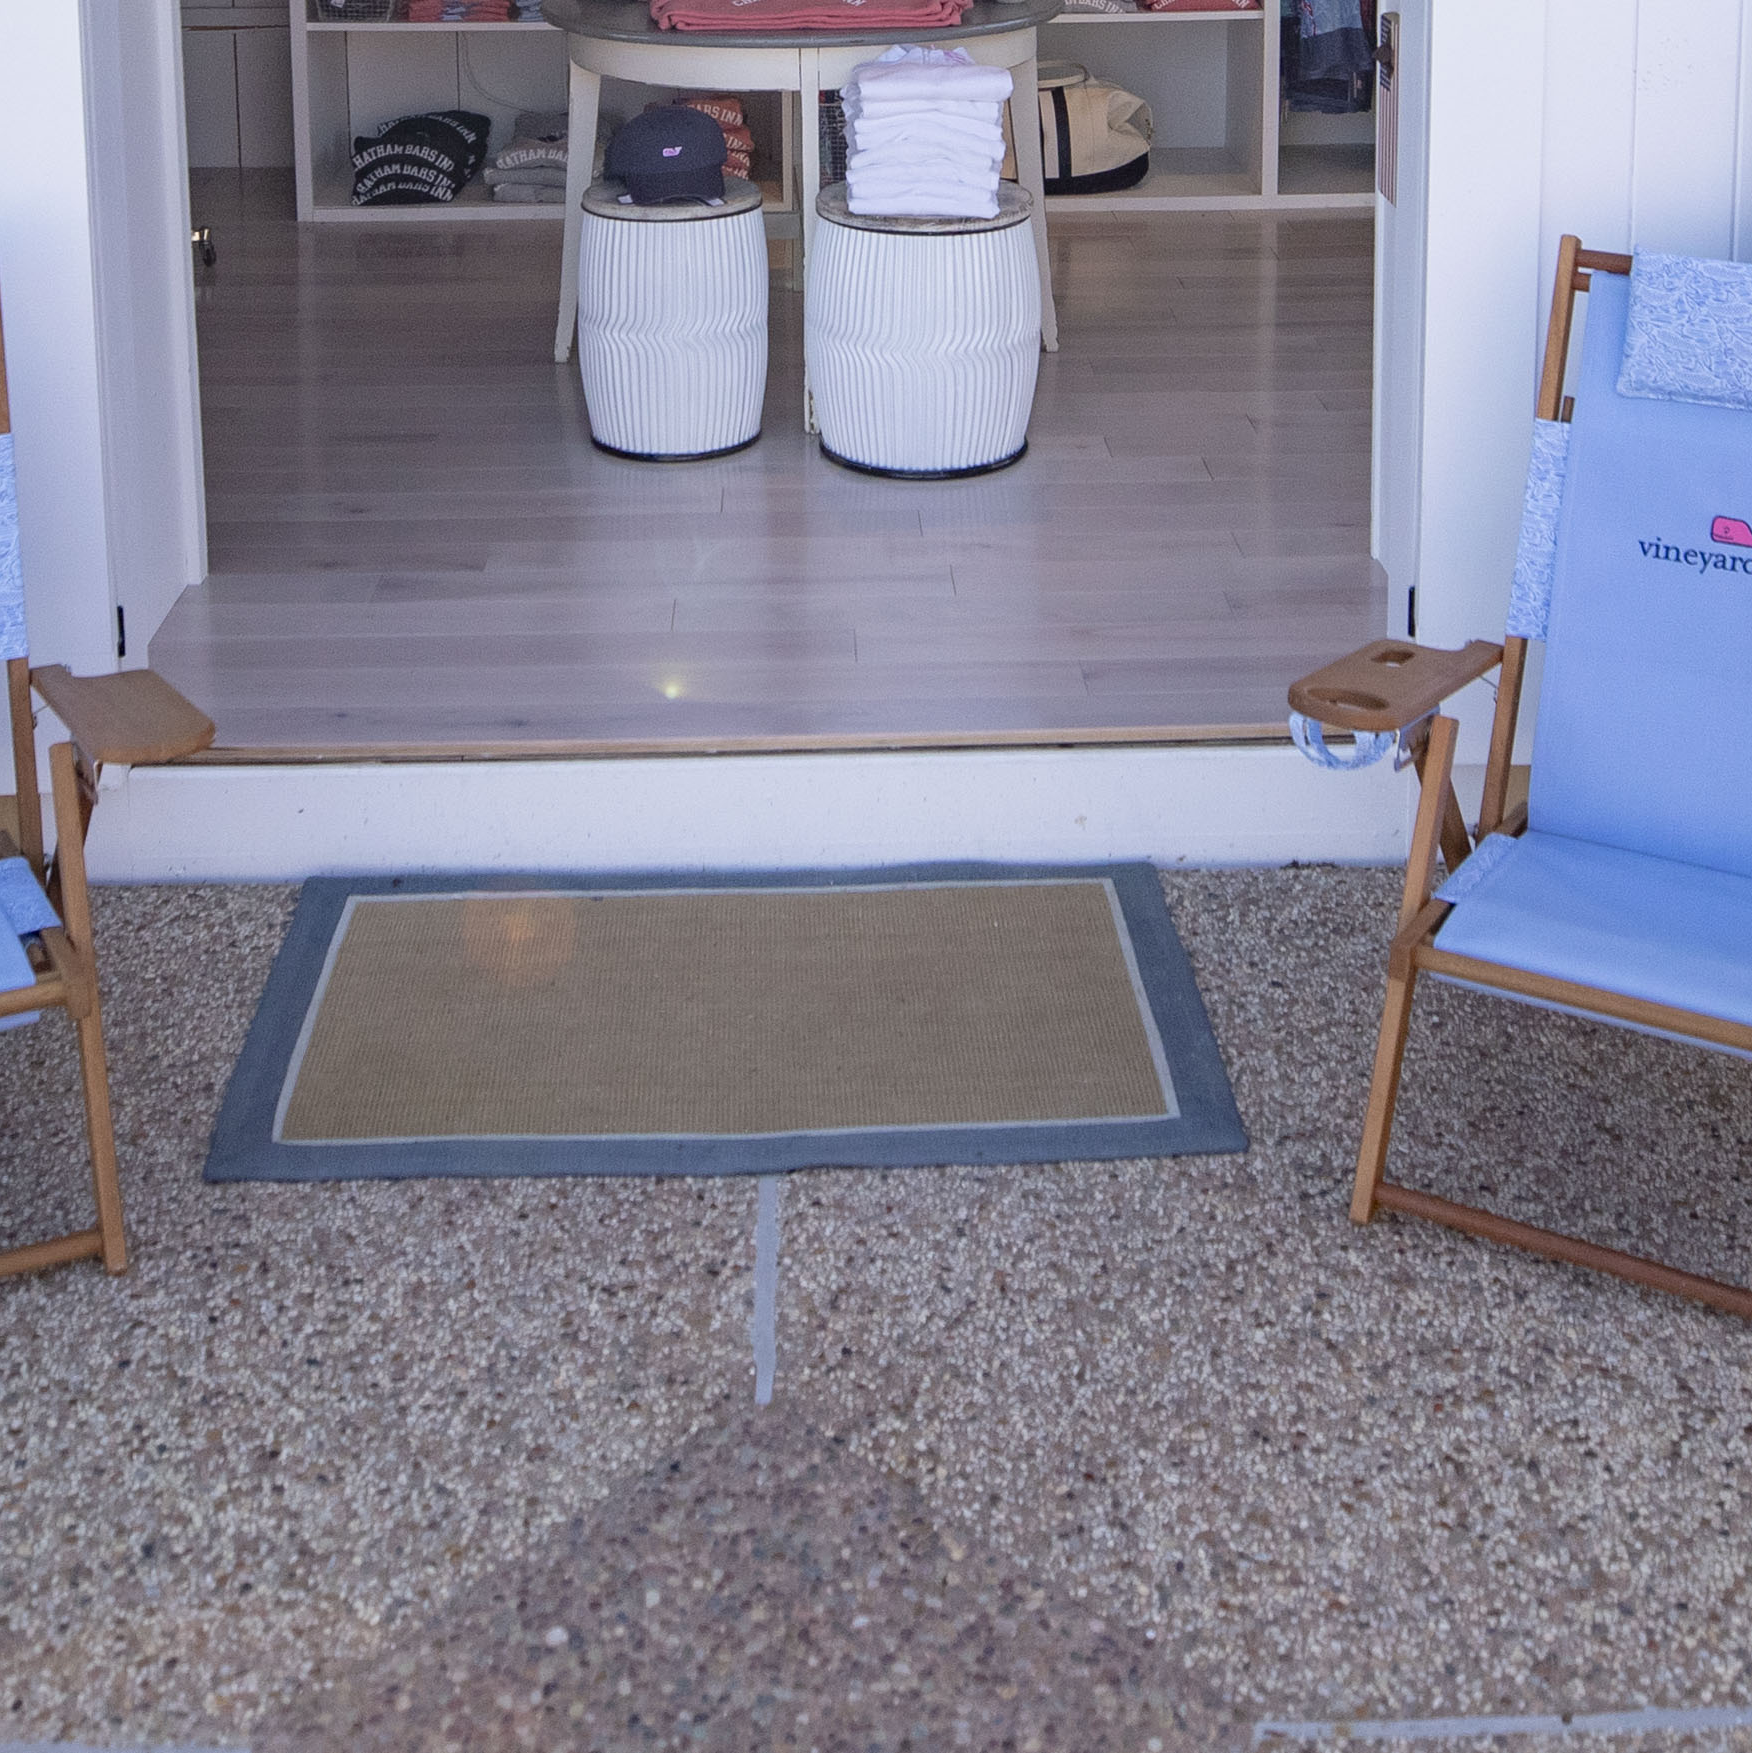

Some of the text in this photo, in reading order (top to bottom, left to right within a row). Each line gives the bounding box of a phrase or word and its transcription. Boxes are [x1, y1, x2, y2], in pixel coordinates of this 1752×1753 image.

[352, 144, 404, 172] HATHAM
[404, 144, 438, 162] BARS
[357, 163, 402, 194] HATHAM
